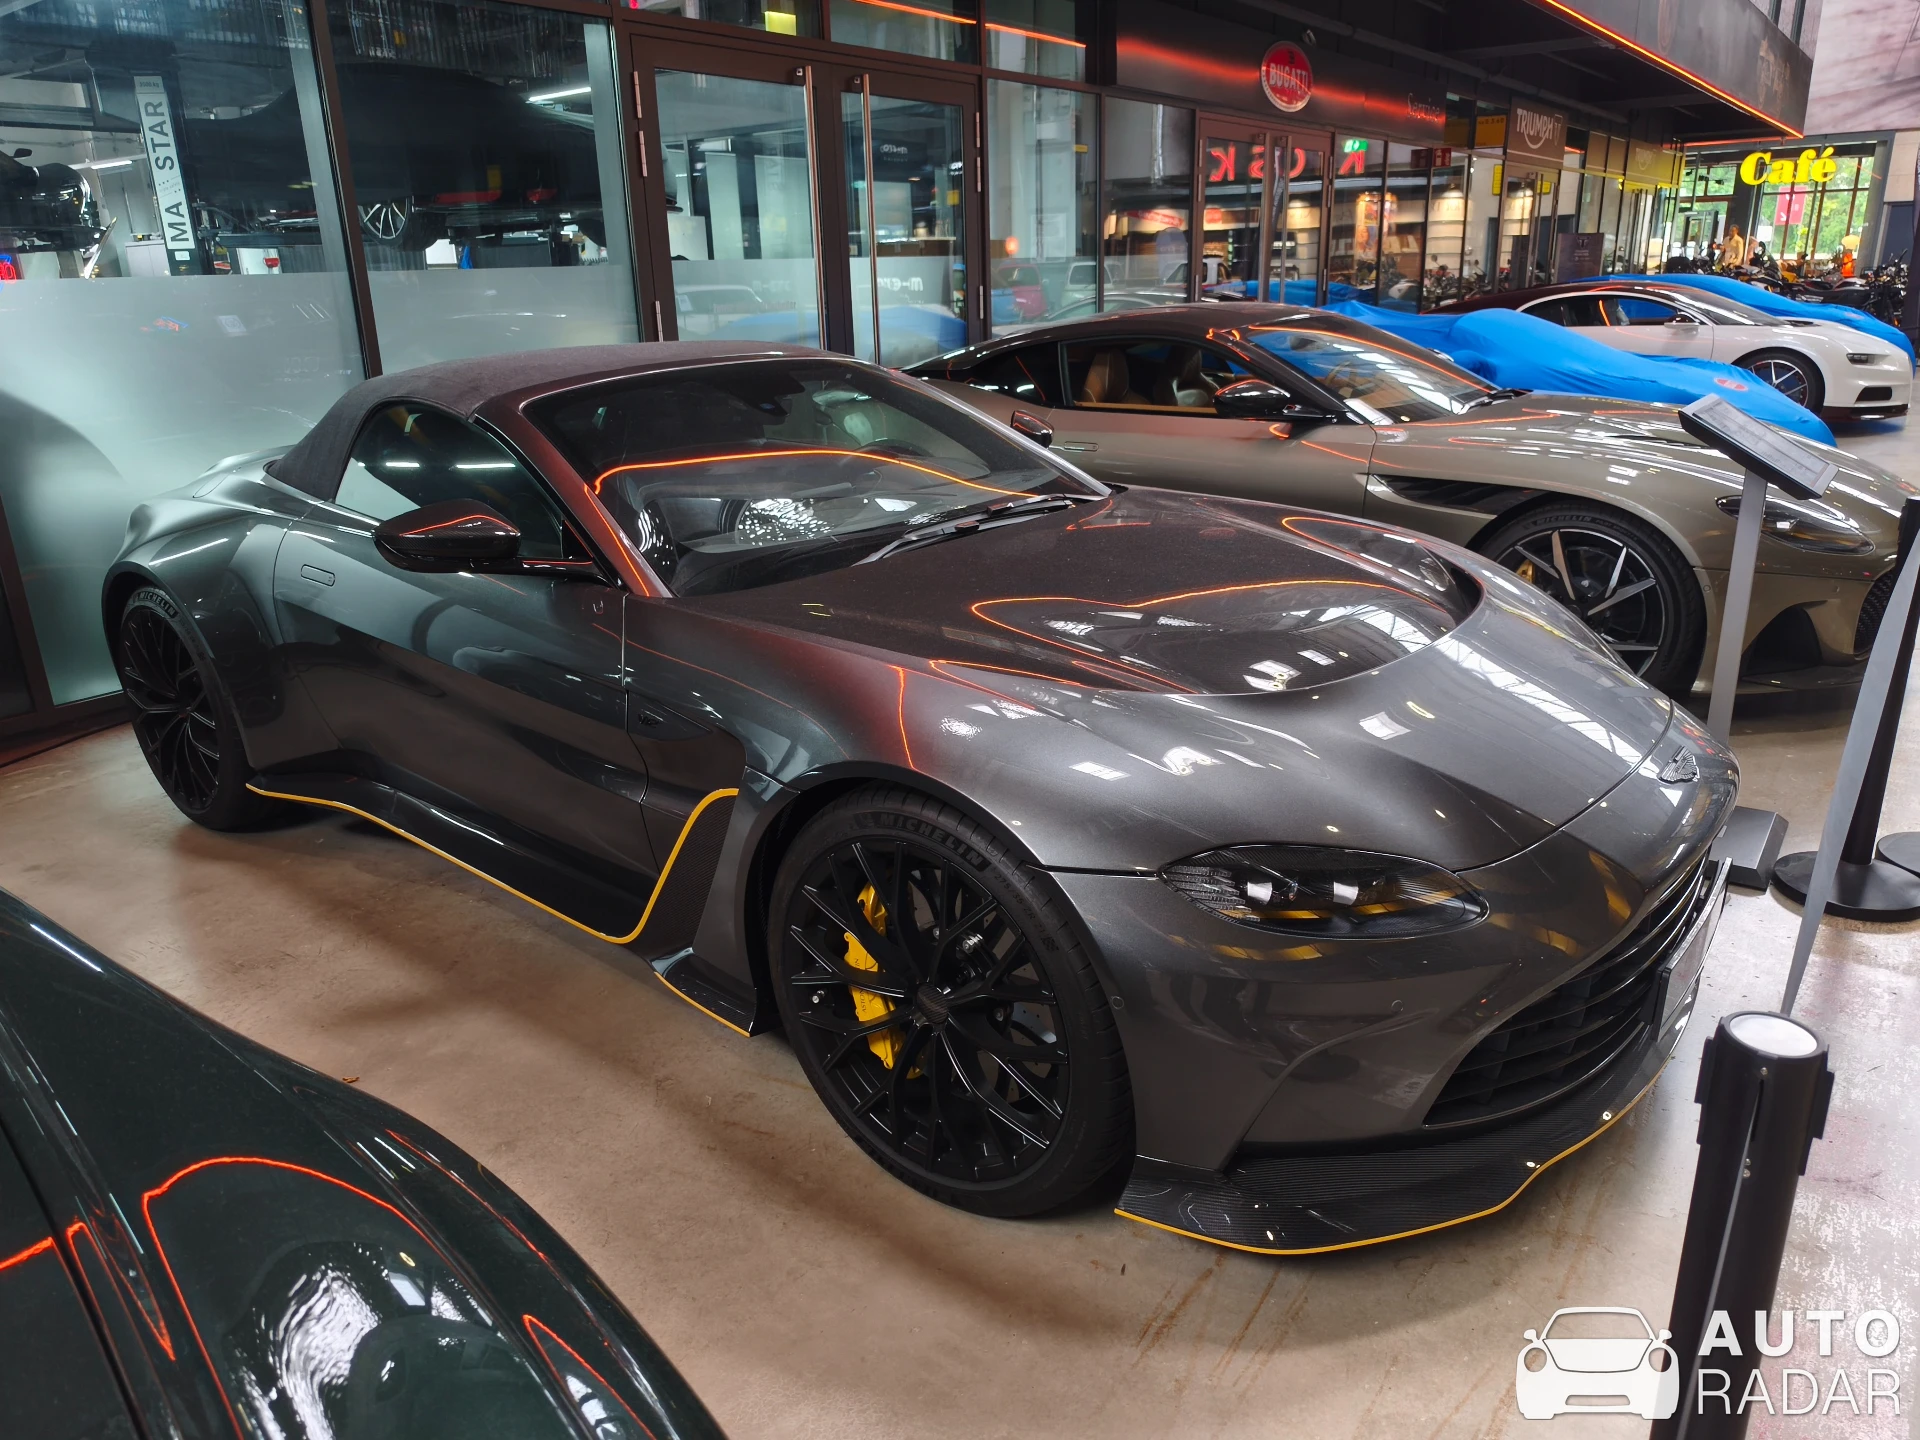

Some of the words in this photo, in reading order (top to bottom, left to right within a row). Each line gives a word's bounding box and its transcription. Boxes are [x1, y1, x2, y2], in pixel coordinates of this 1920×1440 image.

[1269, 63, 1309, 92] BUGATTI
[144, 101, 175, 171] STAR
[1516, 107, 1555, 149] TRIUMPH
[1740, 146, 1837, 186] Café
[164, 201, 190, 243] MA
[1536, 514, 1592, 526] MICHELIN
[139, 591, 176, 616] MICHELIN
[880, 813, 984, 869] MICHELIN
